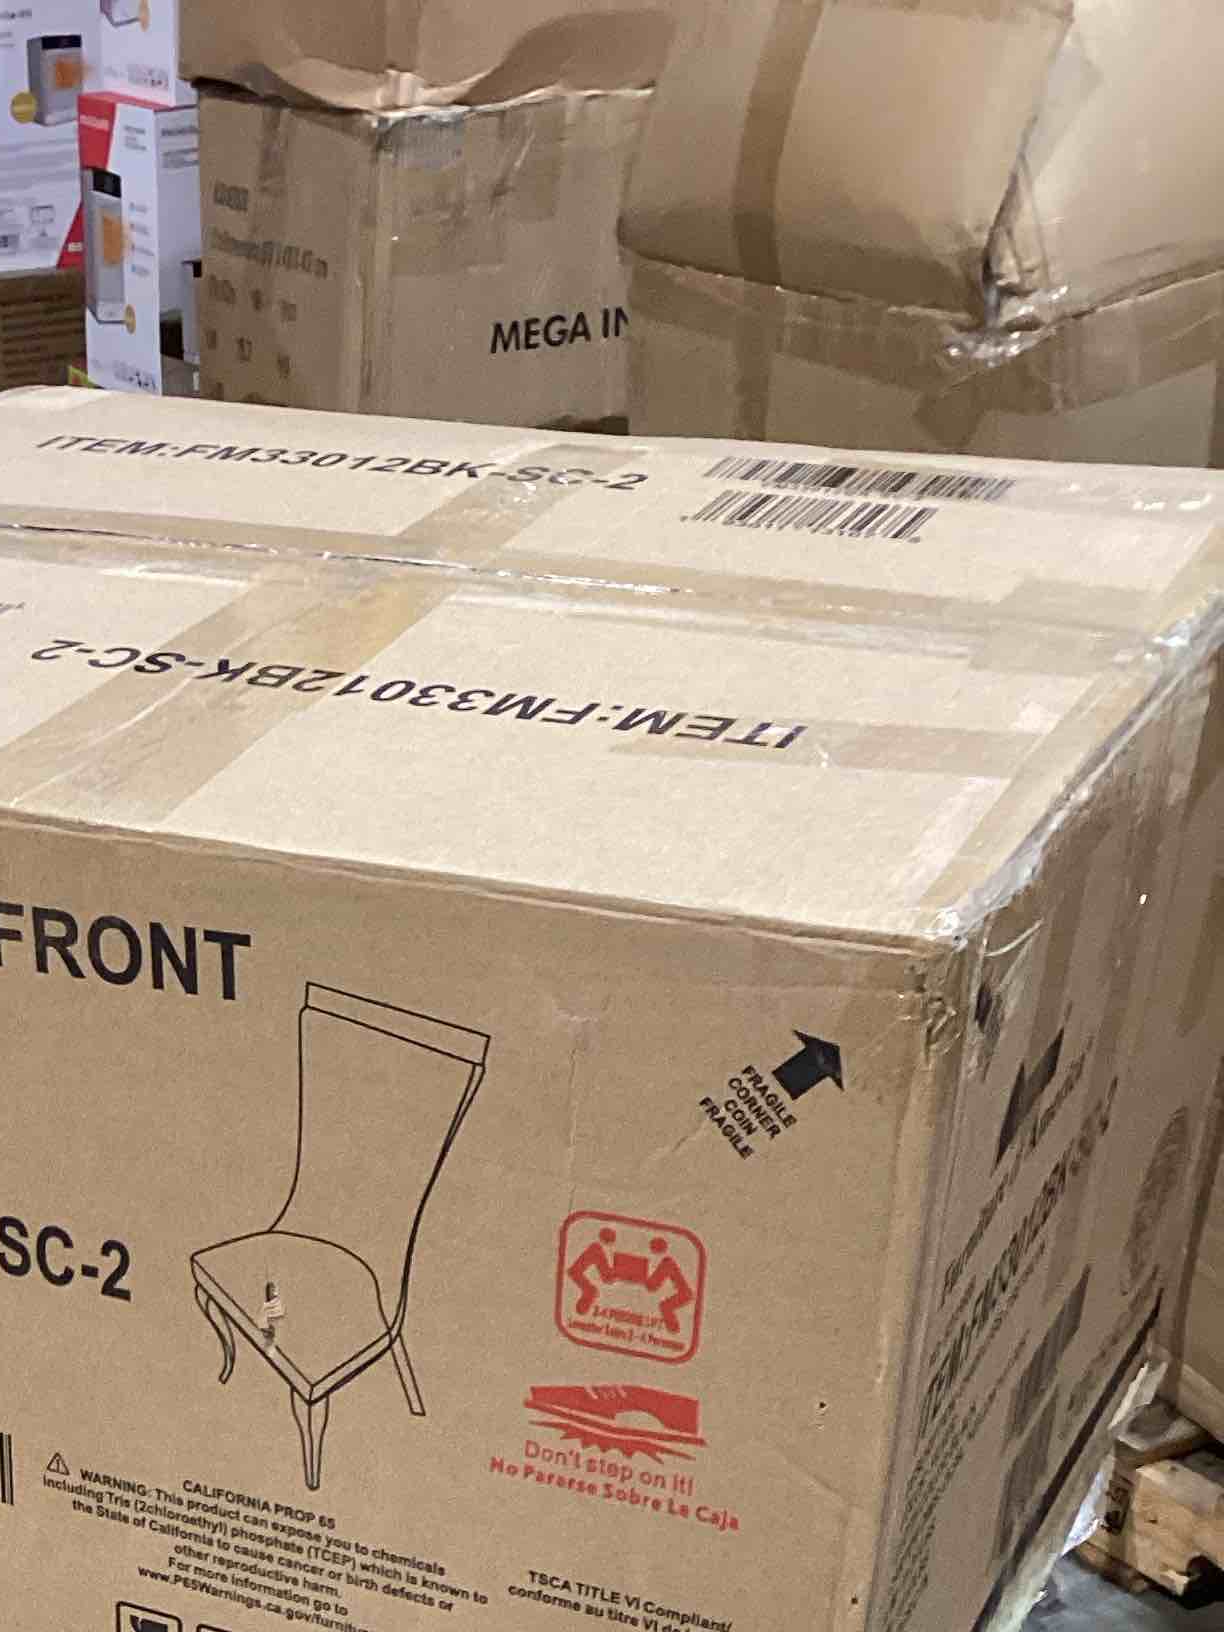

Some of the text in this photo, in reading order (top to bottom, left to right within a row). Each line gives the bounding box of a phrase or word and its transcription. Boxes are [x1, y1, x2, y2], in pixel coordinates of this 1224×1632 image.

[490, 311, 592, 354] MEGA
[36, 435, 649, 491] ITEM:FM33012BK-SC-2
[30, 638, 810, 749] ITEM:FM33012BK-SC-2
[724, 1099, 758, 1136] COIN
[728, 1077, 781, 1141] CORNER
[741, 1064, 798, 1129] FRAGILE
[699, 1096, 755, 1160] FRAGILE
[489, 1456, 740, 1532] No Pararse Sobre La Caja
[523, 1438, 581, 1469] Don't
[585, 1456, 633, 1484] step
[638, 1470, 666, 1489] on
[154, 1486, 184, 1507] This
[186, 1498, 240, 1521] product
[242, 1513, 268, 1529] can
[270, 1520, 322, 1543] expose
[324, 1535, 351, 1551] you
[353, 1541, 369, 1556] to
[370, 1547, 445, 1577] chemicals
[181, 1478, 336, 1530] CALIFORNIA PROP 65
[41, 1473, 104, 1504] including
[104, 1490, 131, 1509] Tris
[229, 1525, 304, 1555] phosphate
[306, 1544, 356, 1572] (TCEP)
[358, 1561, 402, 1581] which
[405, 1570, 418, 1586] is
[420, 1574, 470, 1600] known
[472, 1590, 488, 1605] to
[71, 1498, 454, 1612] the State of California to cause cancer or birth defects or
[173, 1543, 210, 1561] other
[211, 1554, 299, 1586] reproductive
[167, 1555, 349, 1617] For more information go to
[507, 1584, 581, 1612] conforme
[584, 1603, 604, 1617] au
[606, 1607, 639, 1627] titre
[641, 1615, 658, 1632] VI
[528, 1569, 572, 1593] TSCA
[574, 1581, 621, 1605] TITLE
[623, 1594, 641, 1610] VI
